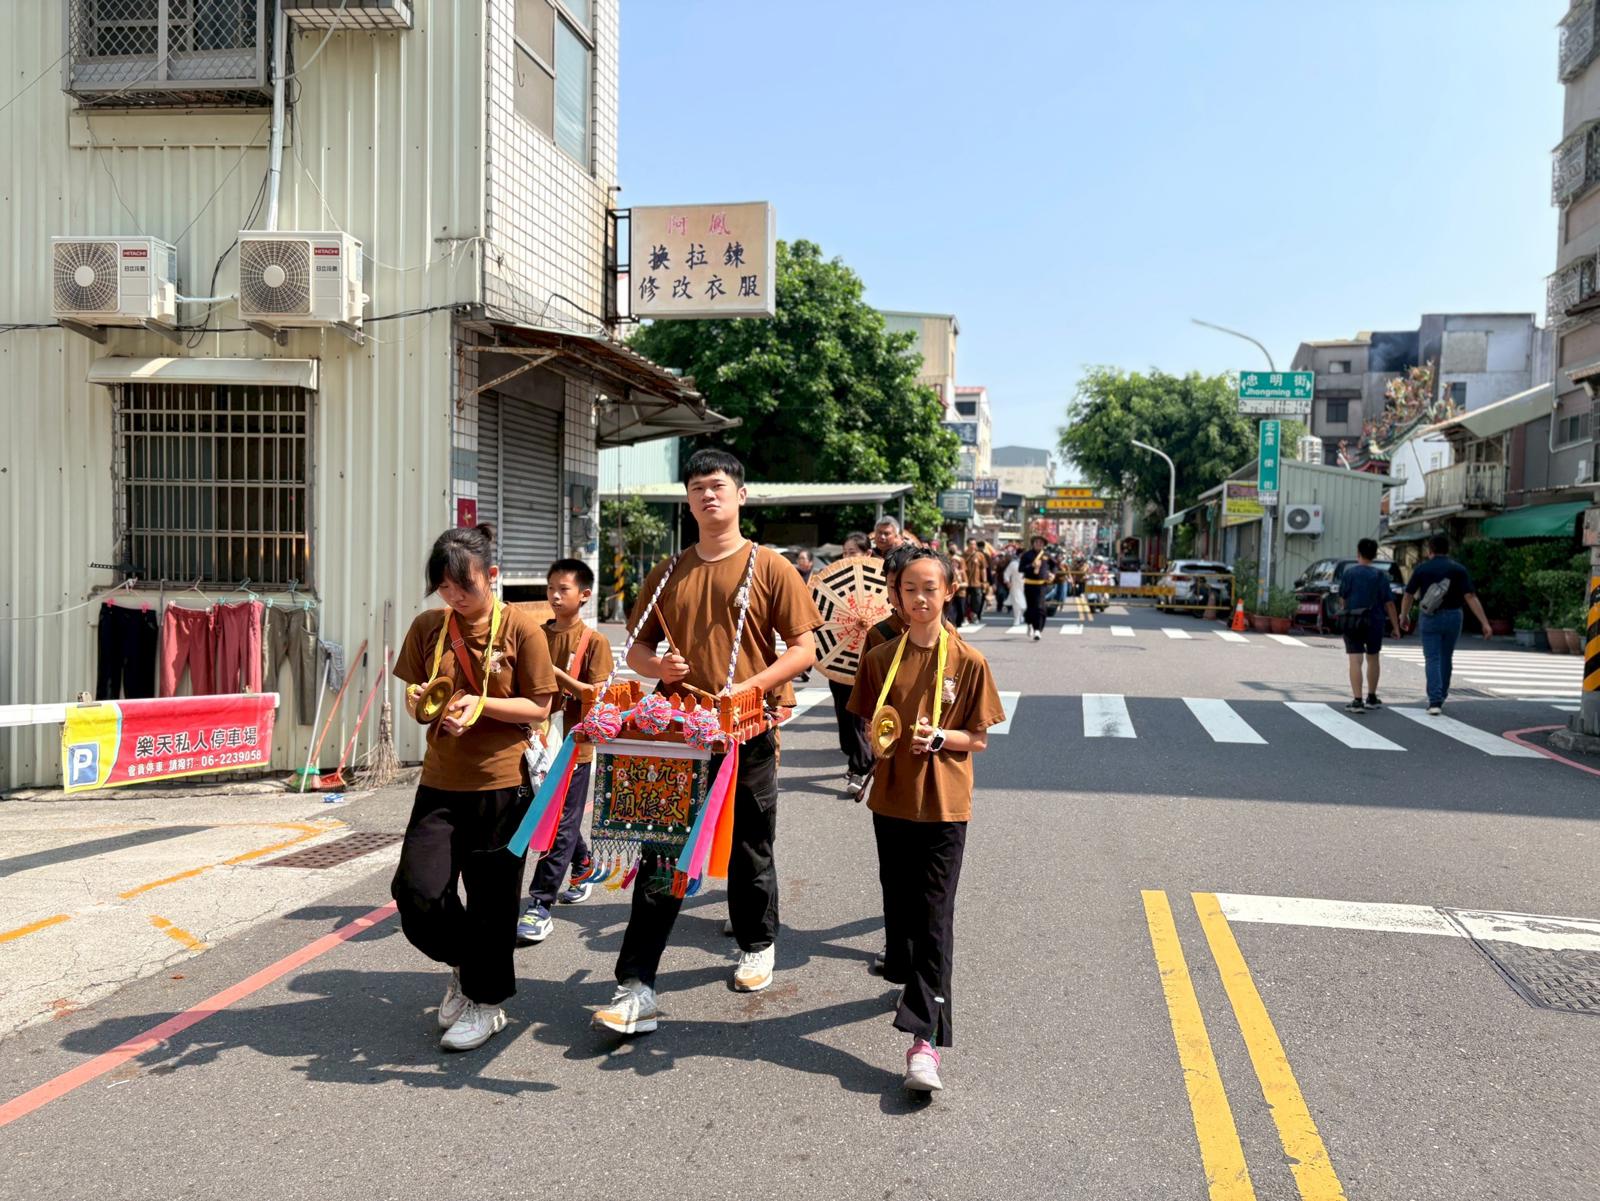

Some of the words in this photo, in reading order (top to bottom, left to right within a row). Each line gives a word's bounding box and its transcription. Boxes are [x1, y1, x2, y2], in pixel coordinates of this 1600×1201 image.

[668, 213, 731, 236] 阿鳳
[638, 274, 760, 303] 修改衣服
[1246, 373, 1307, 387] 忠明街
[1245, 388, 1291, 397] Jhongming
[1294, 387, 1306, 397] St.
[136, 726, 258, 758] 樂天私人停車場
[72, 747, 93, 782] P
[201, 750, 262, 767] 06-2239058
